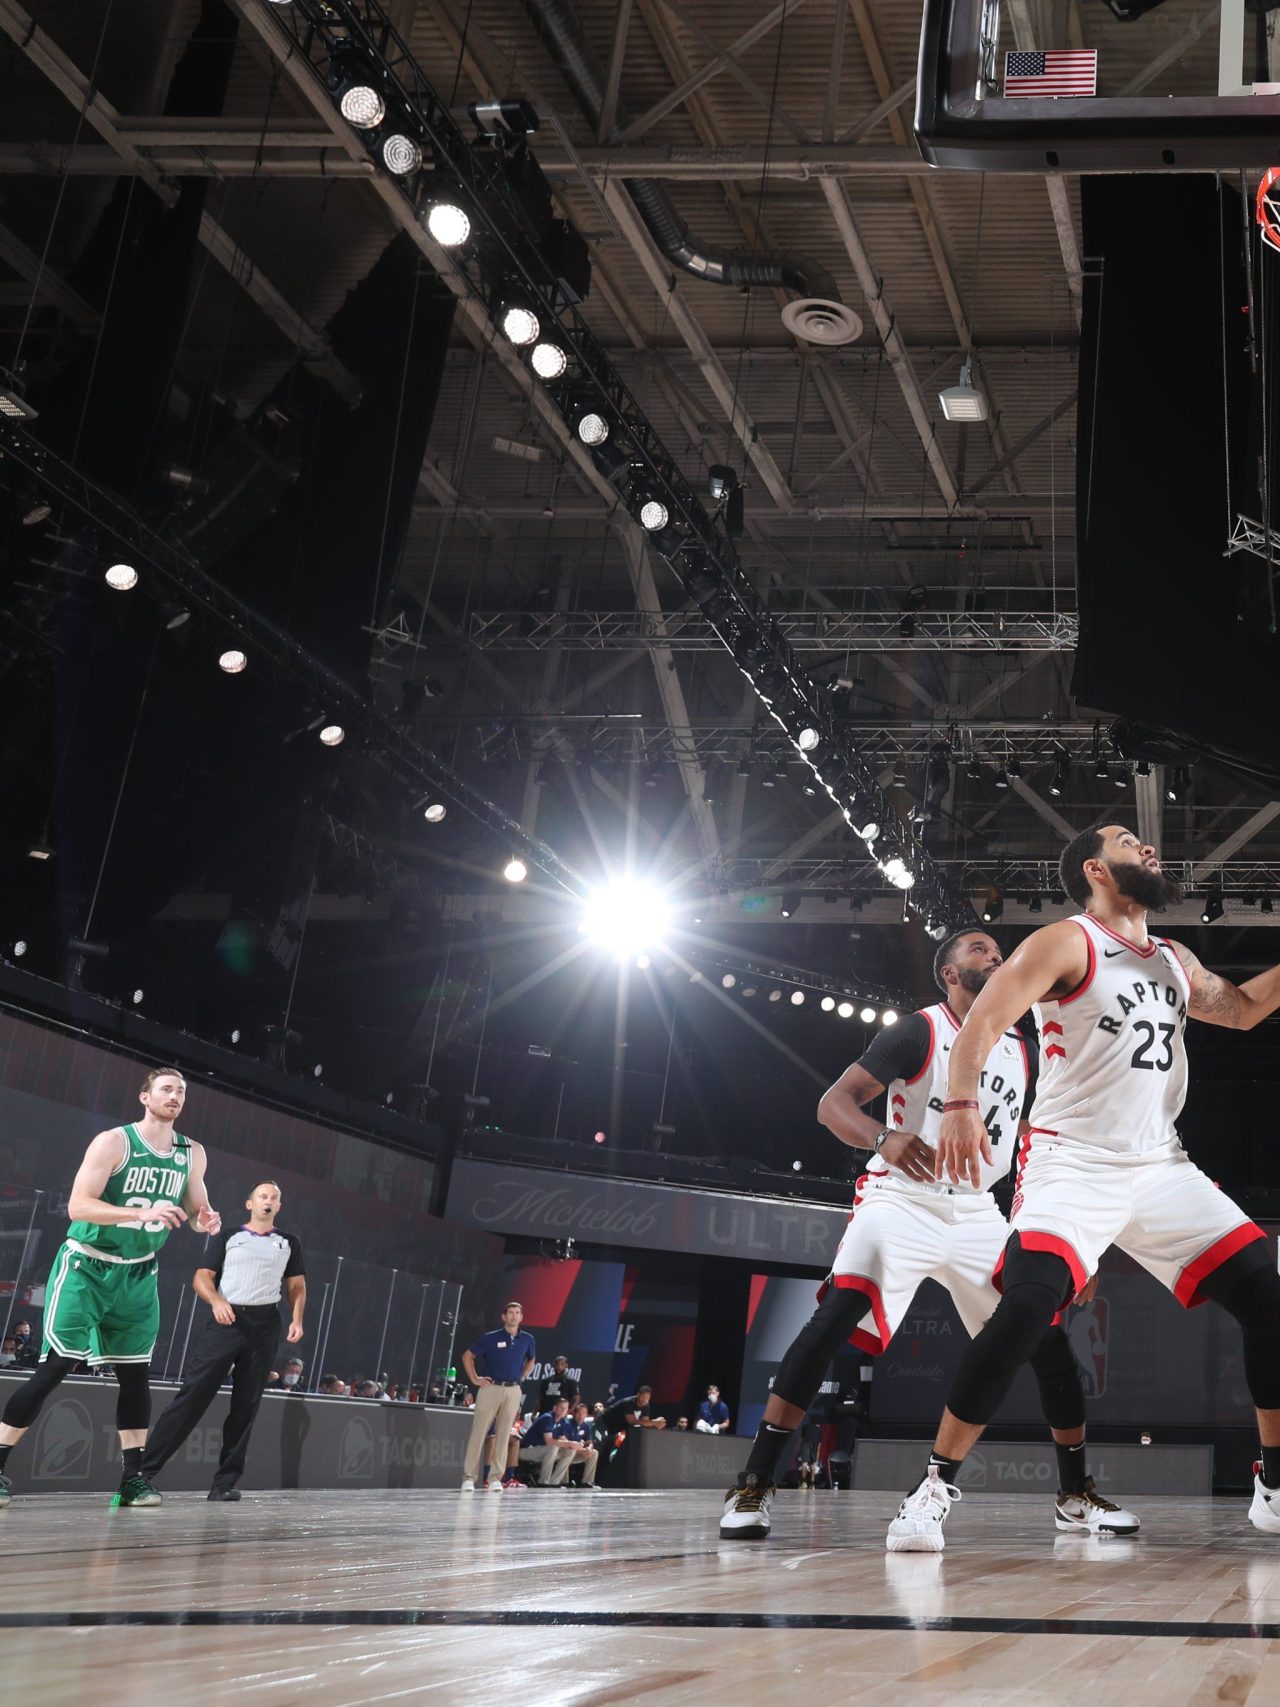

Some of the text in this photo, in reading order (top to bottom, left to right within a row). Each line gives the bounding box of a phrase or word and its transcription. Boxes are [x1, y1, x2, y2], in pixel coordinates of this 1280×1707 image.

[1098, 980, 1188, 1038] RAPTOR
[1131, 1020, 1175, 1072] 23
[928, 1070, 1020, 1121] RTORS
[122, 1167, 186, 1199] BOSTON
[473, 1181, 664, 1236] Michelob
[707, 1204, 832, 1256] ULTR
[901, 1319, 953, 1336] LTRA
[184, 1426, 224, 1463] BE
[379, 1436, 426, 1466] TACO
[993, 1461, 1052, 1481] TACO
